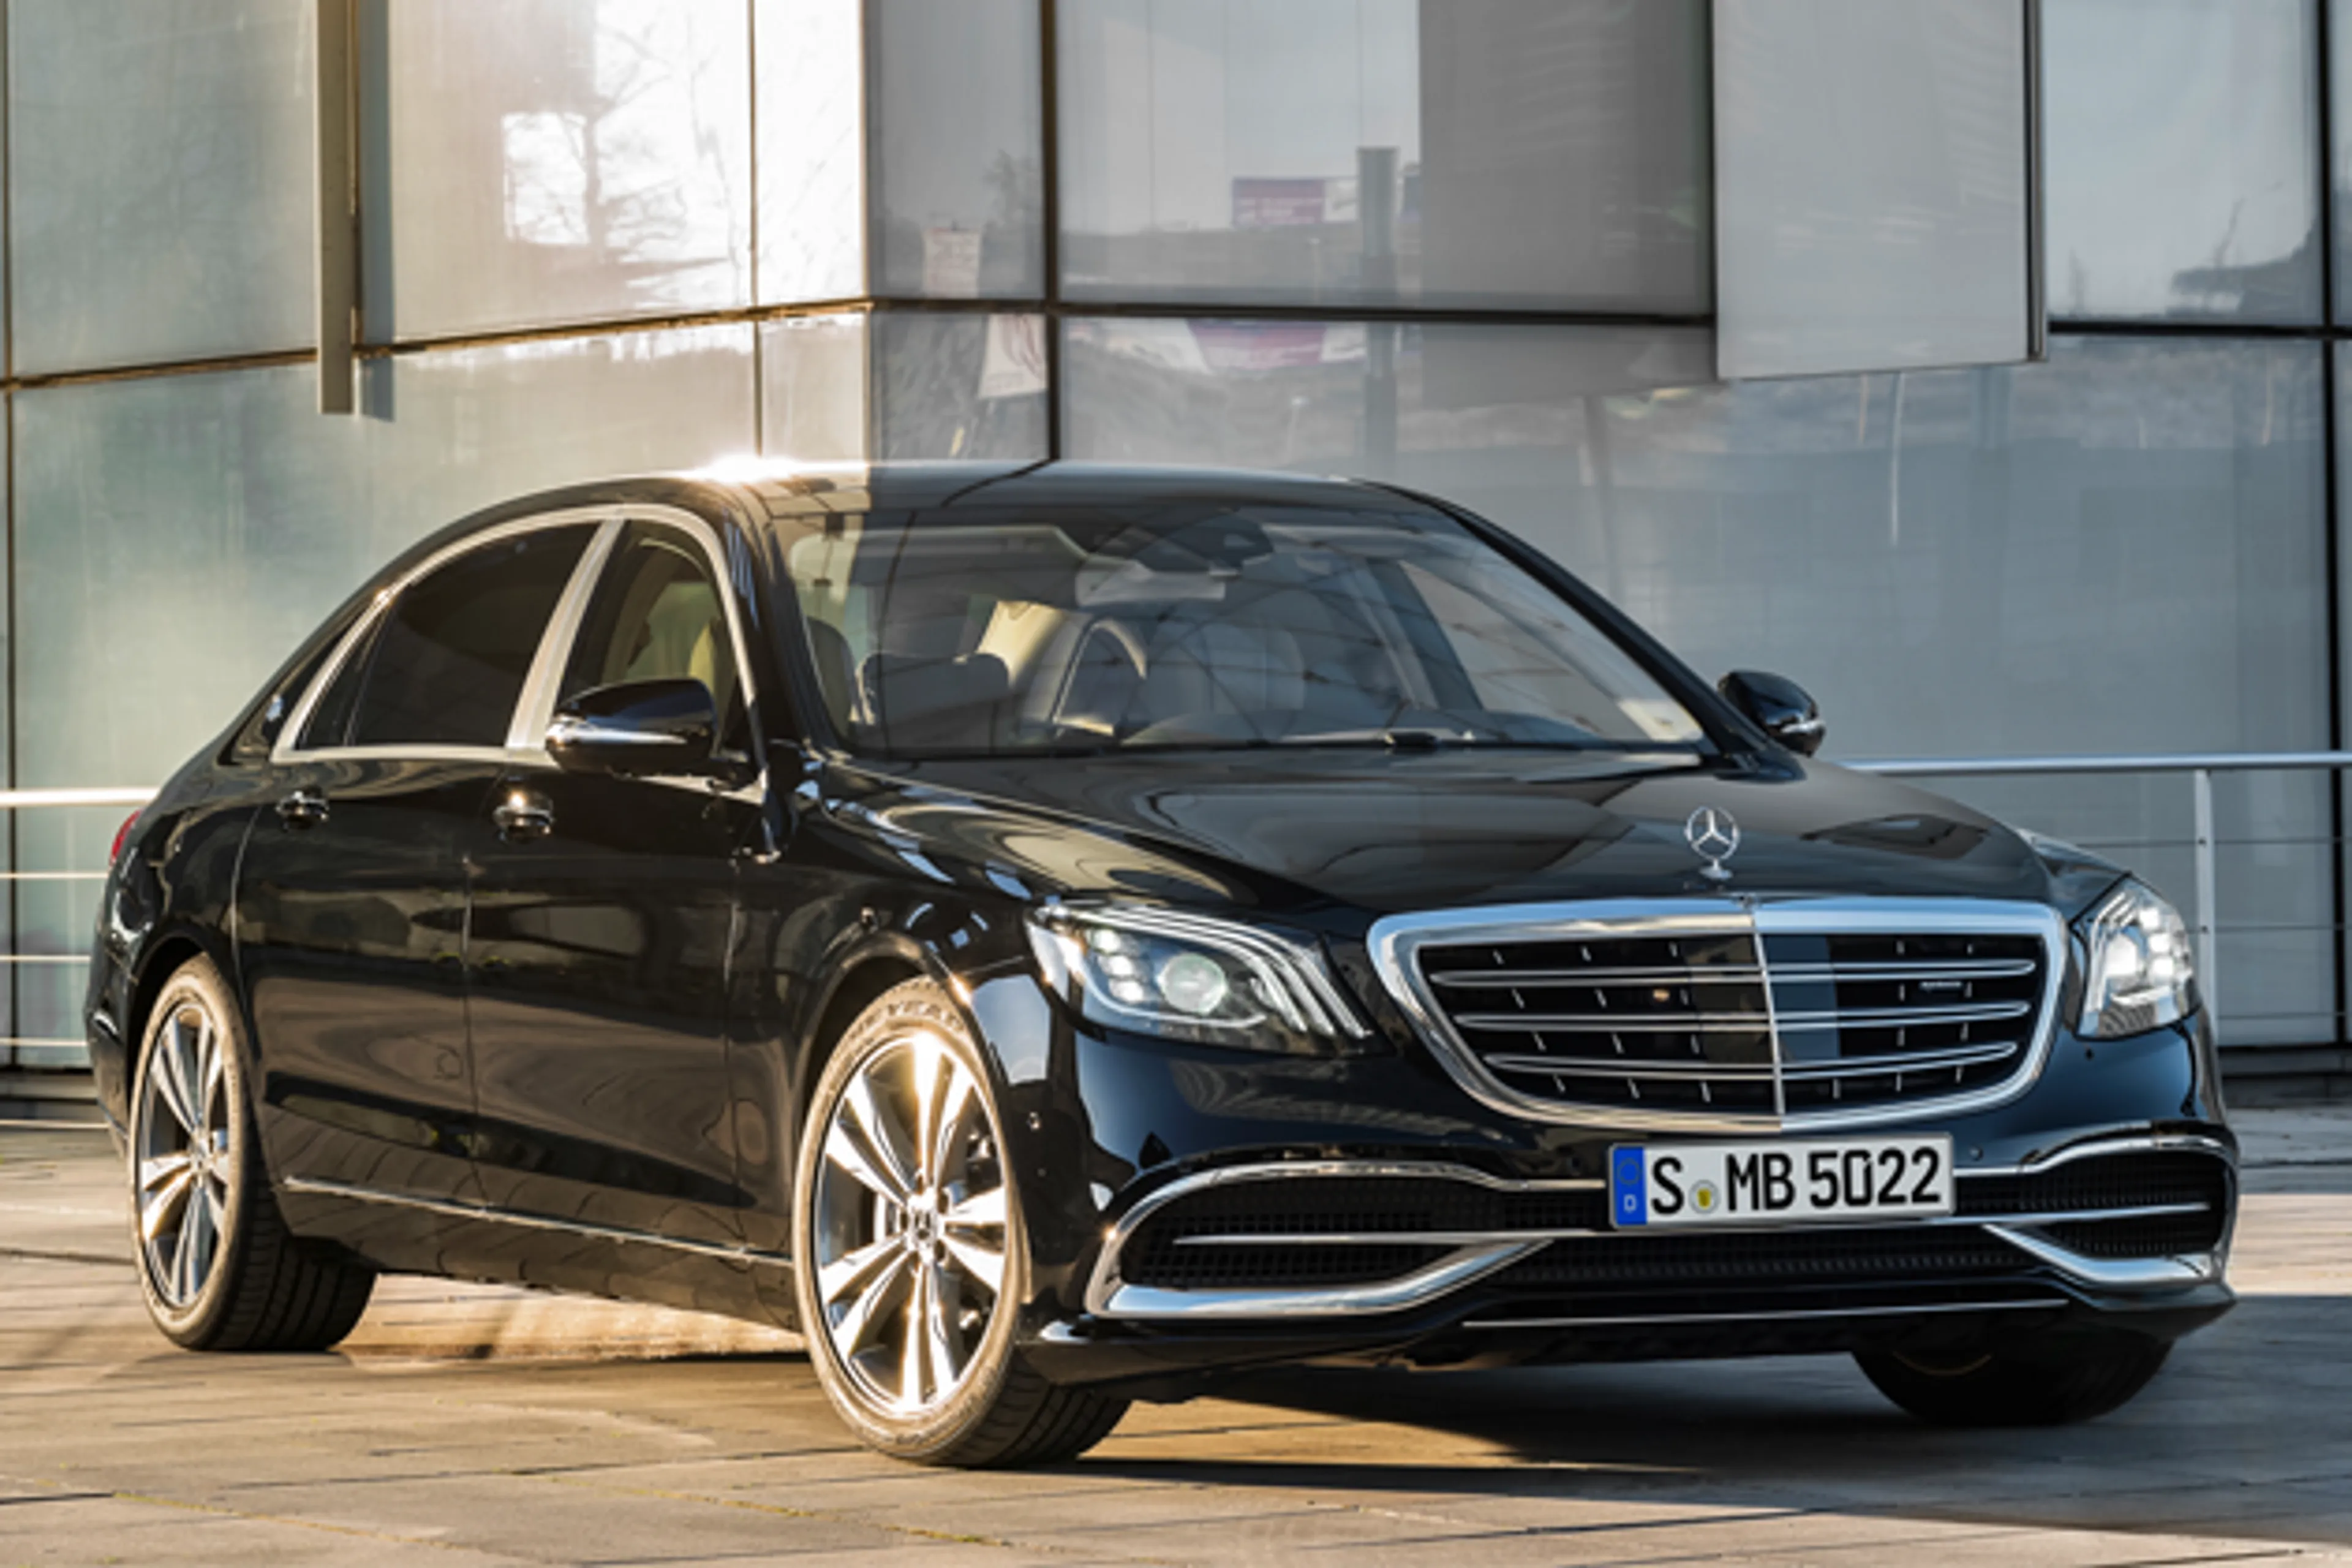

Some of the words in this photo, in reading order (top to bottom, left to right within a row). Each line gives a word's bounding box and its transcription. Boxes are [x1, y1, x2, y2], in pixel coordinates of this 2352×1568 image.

[1651, 1156, 1684, 1215] S
[1725, 1153, 1796, 1212] MB
[1807, 1146, 1940, 1208] 5022
[1624, 1194, 1636, 1212] D
